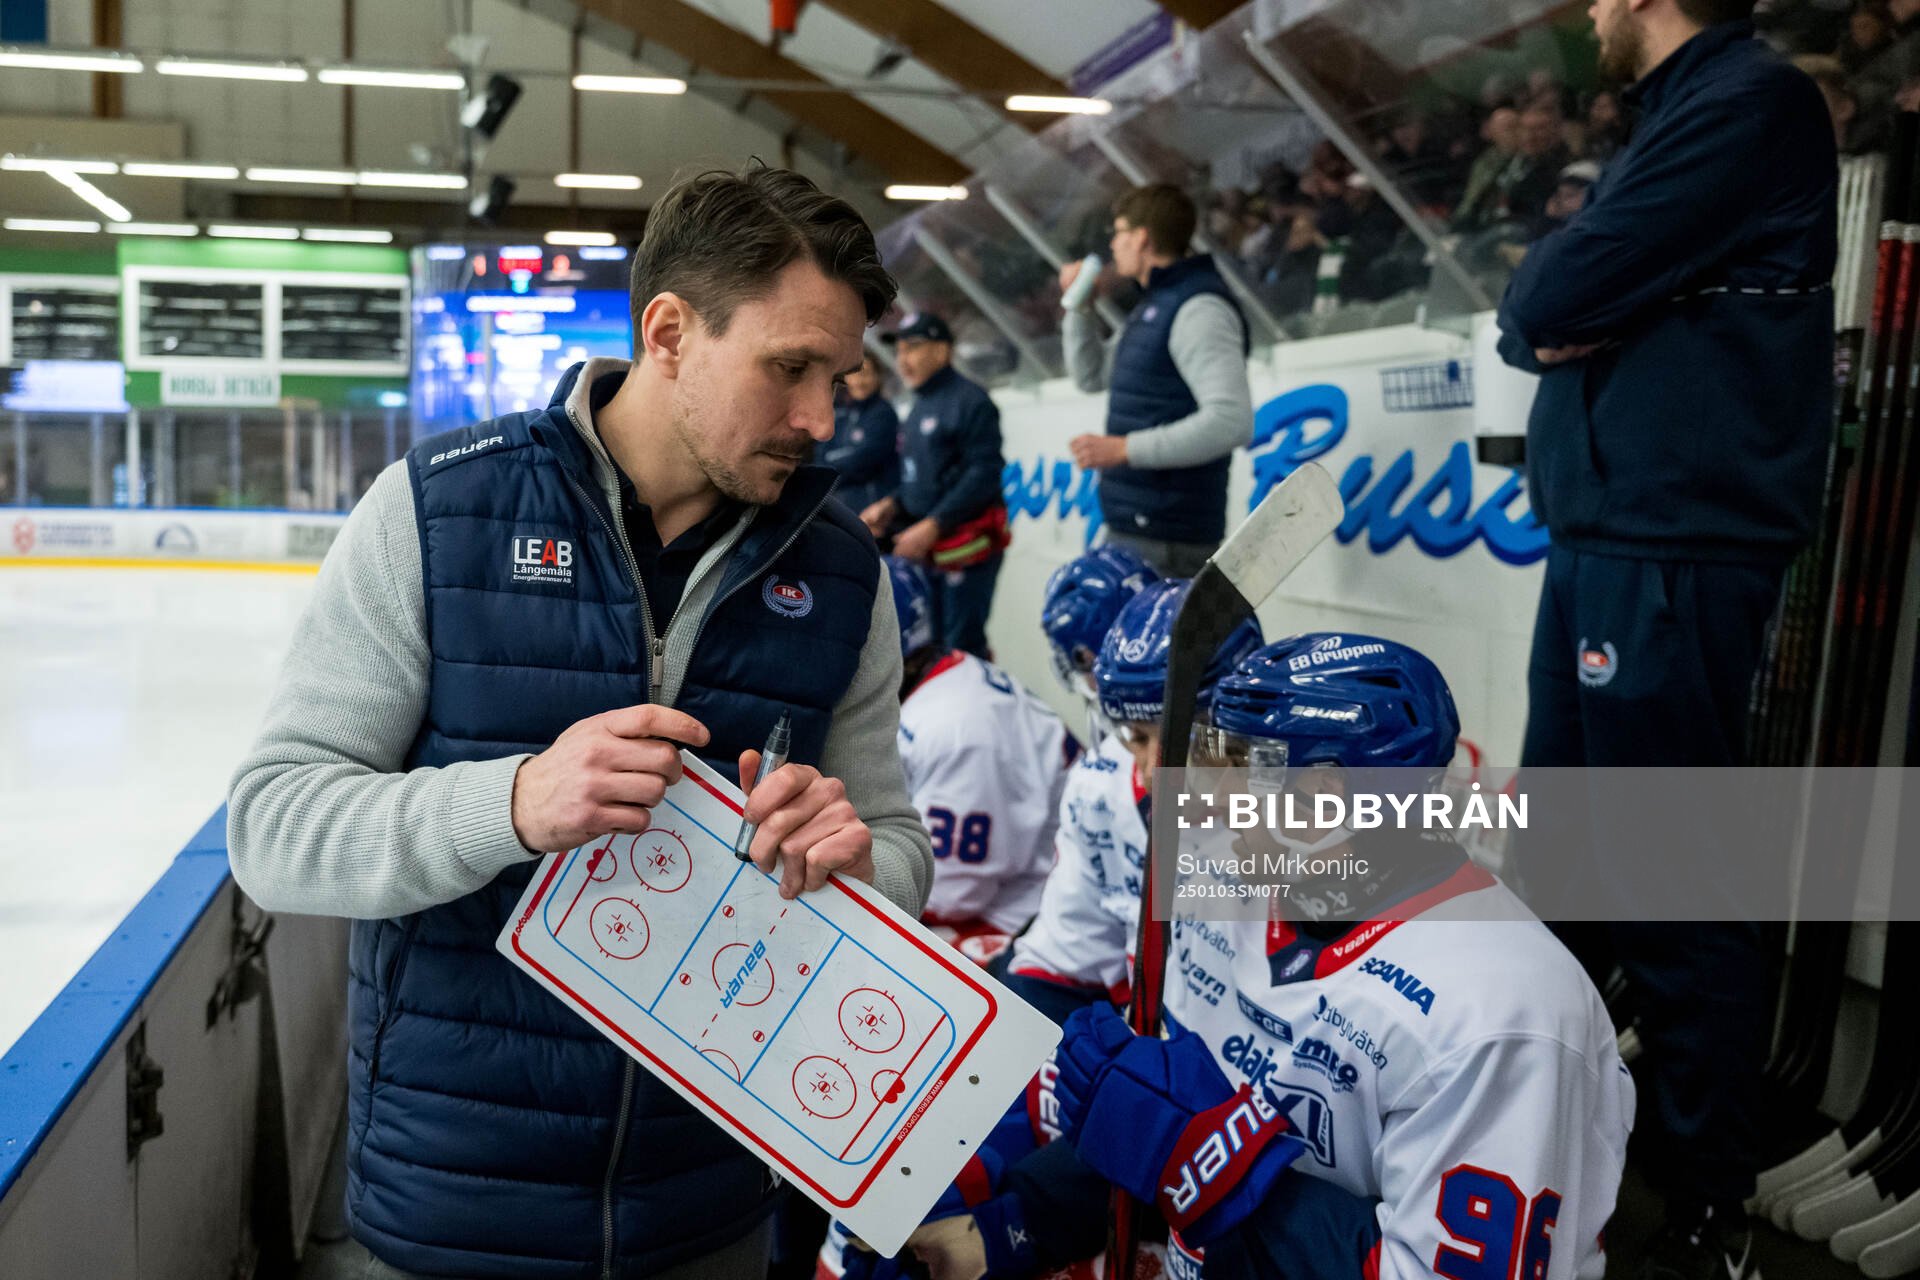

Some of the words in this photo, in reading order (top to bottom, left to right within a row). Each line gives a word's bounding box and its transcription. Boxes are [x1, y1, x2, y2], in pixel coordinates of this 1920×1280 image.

[513, 564, 572, 577] Långemåla
[514, 538, 573, 567] LEAB
[781, 586, 797, 598] IK
[1288, 654, 1311, 672] EB
[1311, 643, 1385, 665] Gruppen
[926, 805, 993, 866] 38
[720, 939, 766, 1009] BAUER
[1358, 957, 1436, 1016] SCANIA
[1433, 1162, 1564, 1280] 96
